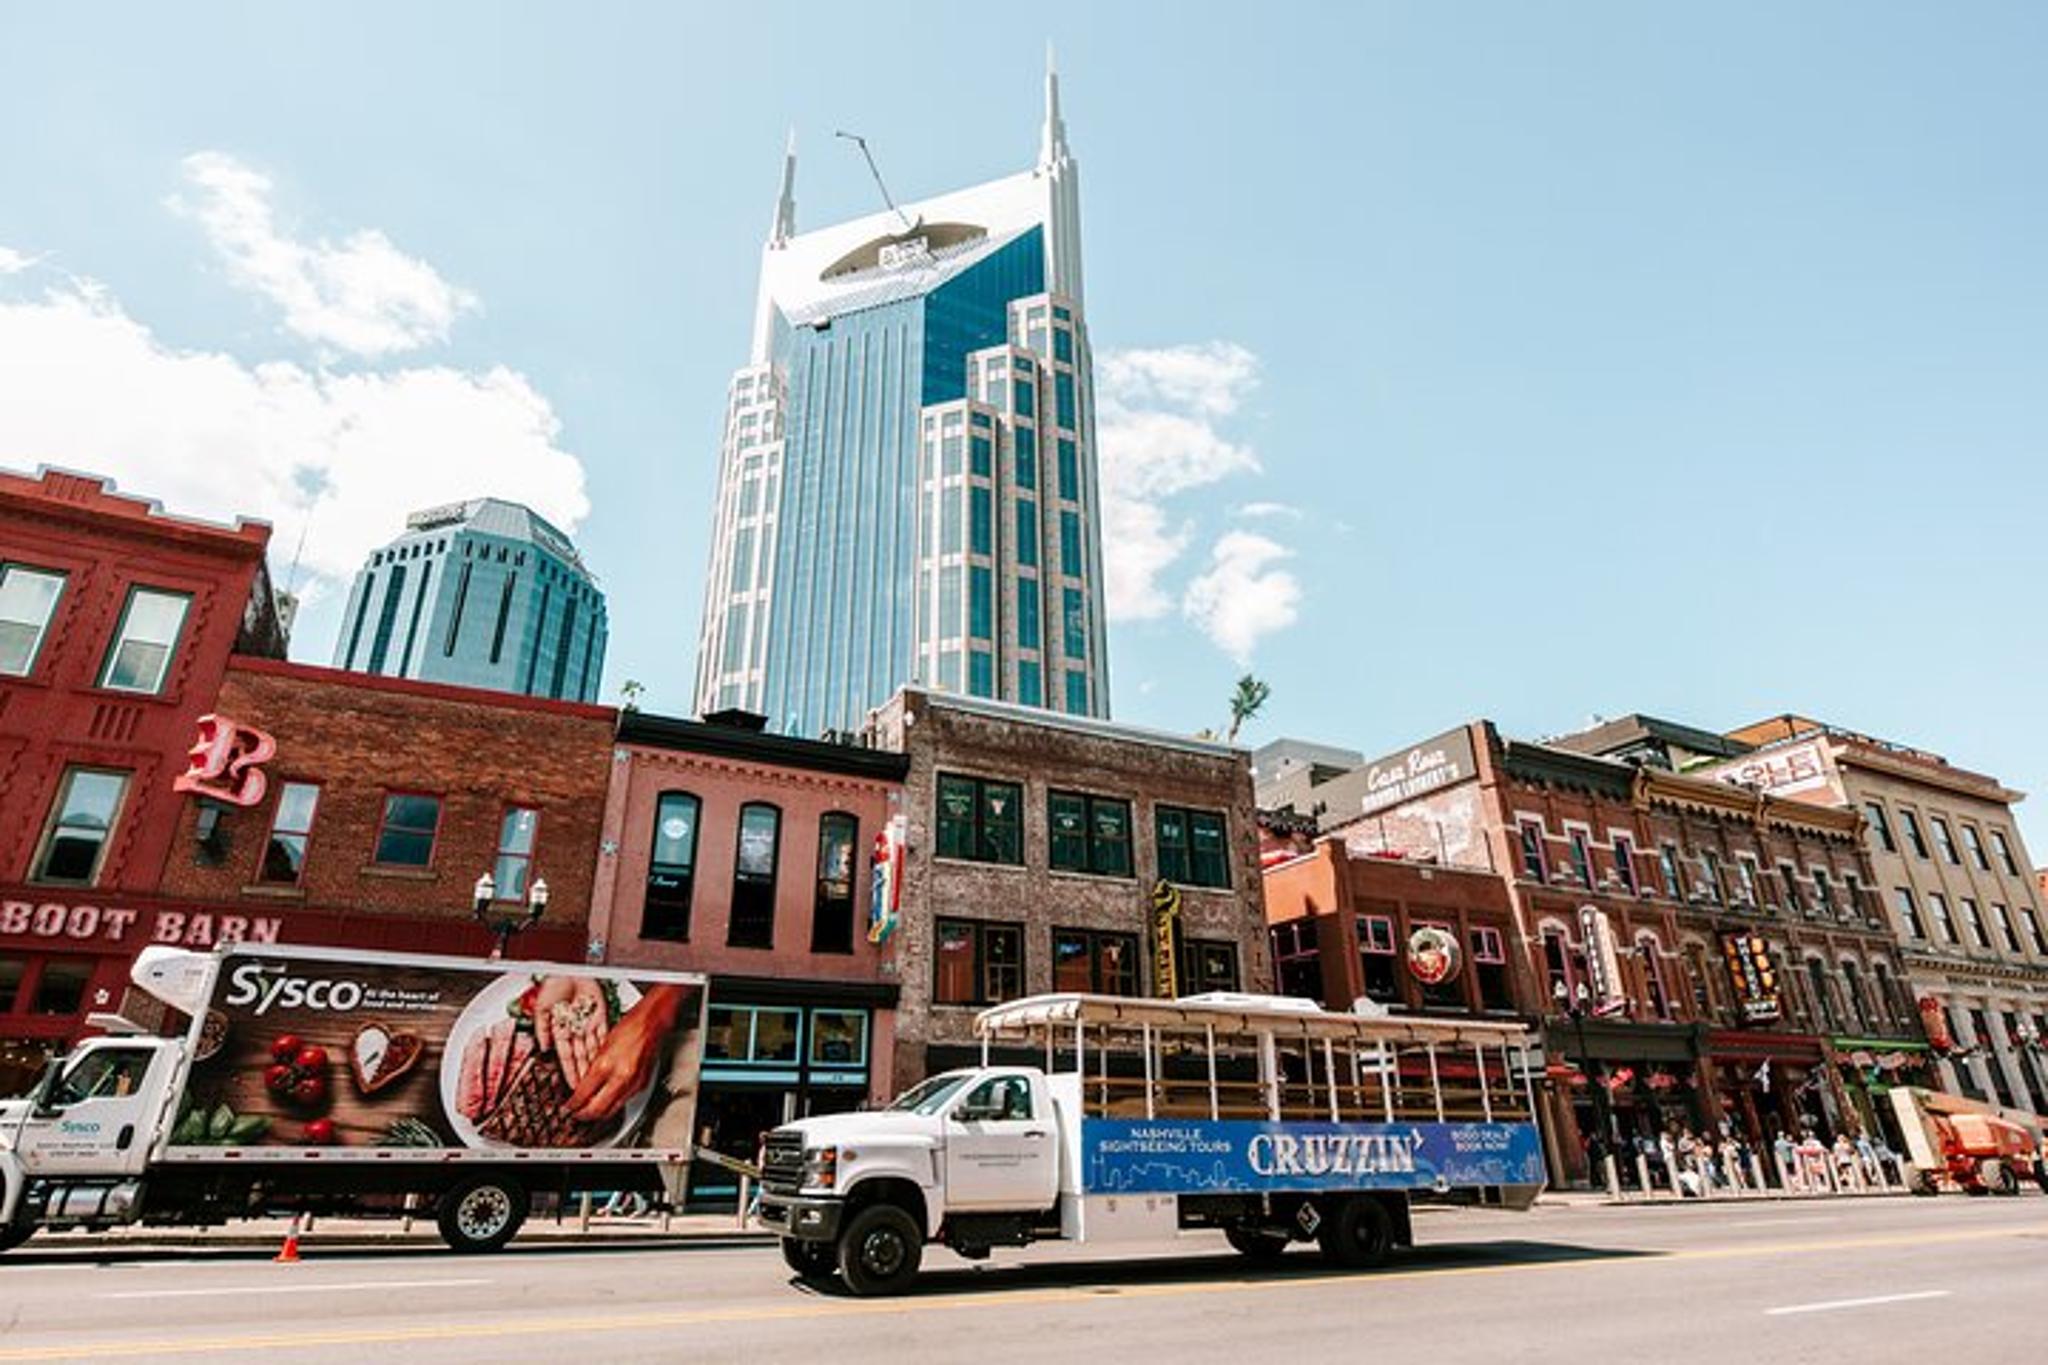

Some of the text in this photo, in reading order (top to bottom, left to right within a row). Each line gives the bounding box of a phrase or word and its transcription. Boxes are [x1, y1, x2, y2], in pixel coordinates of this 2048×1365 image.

[1238, 806, 1273, 991] VALENTIN
[1, 901, 282, 945] BOOT BARN
[379, 989, 397, 999] the
[398, 990, 427, 1001] heart
[1130, 1128, 1202, 1139] NASHVILLE
[1099, 1139, 1232, 1153] SIGHTSEEING TOURS
